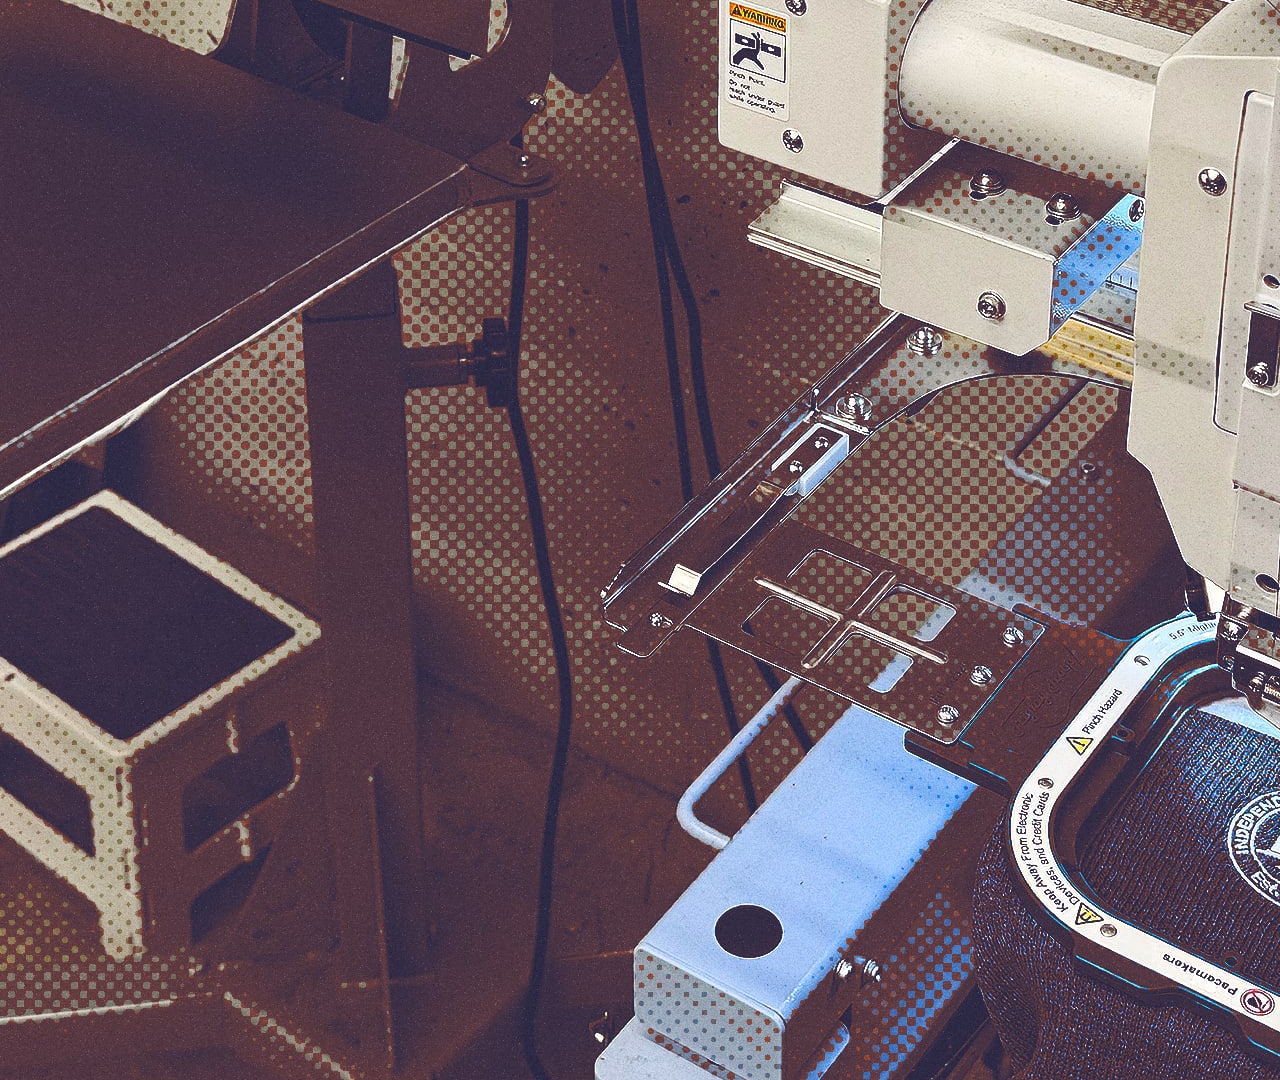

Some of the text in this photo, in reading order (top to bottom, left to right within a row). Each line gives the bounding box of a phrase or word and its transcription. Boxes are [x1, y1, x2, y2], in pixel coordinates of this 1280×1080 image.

[1082, 688, 1123, 734] Pinch Hazard
[1032, 791, 1050, 817] Cards
[1031, 818, 1043, 846] Credit
[1019, 837, 1032, 862] From
[1033, 847, 1050, 865] and
[1026, 863, 1048, 888] Away
[1044, 888, 1069, 913] Keep
[1162, 953, 1239, 996] Pacemakers
